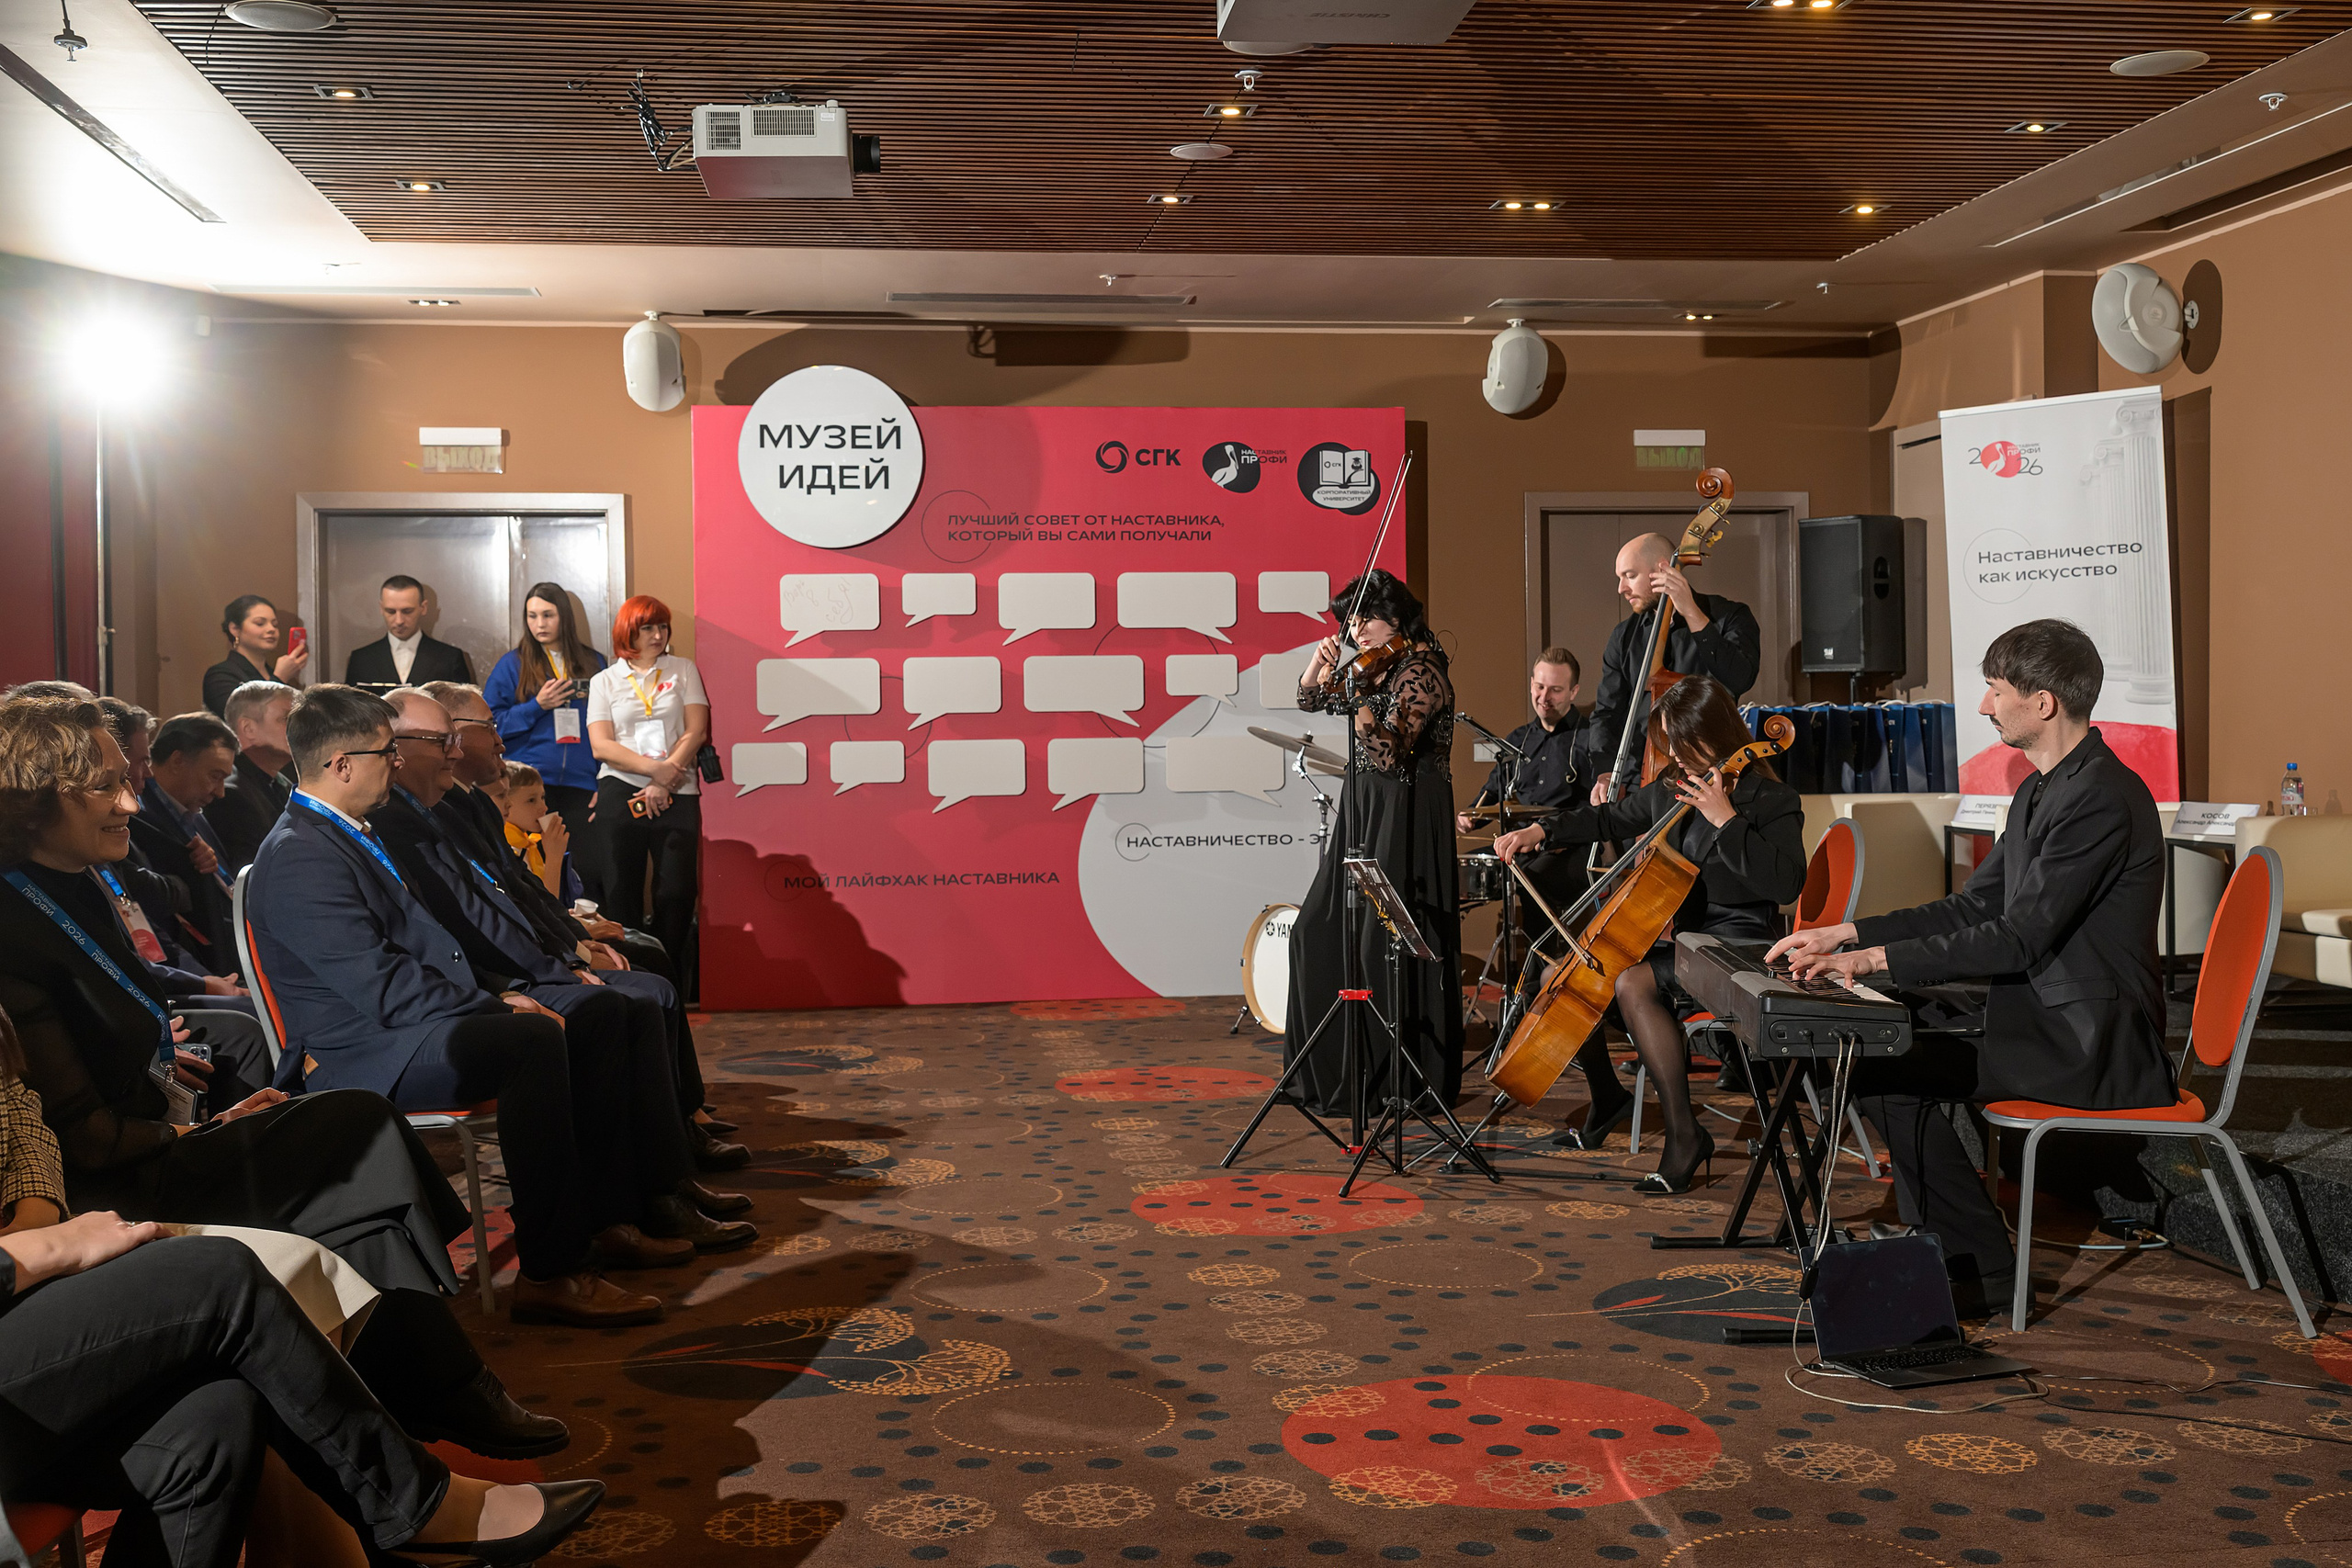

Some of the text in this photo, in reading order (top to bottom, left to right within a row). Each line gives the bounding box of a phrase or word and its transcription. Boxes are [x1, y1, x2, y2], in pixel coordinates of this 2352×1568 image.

[759, 418, 902, 449] МУЗЕЙ
[1136, 448, 1182, 466] СГК
[1241, 456, 1287, 464] ПРОФИ
[2007, 447, 2041, 457] ПРОФИ
[778, 457, 889, 495] ИДЕЙ
[948, 512, 1225, 527] ЛУЧШИЙ СОВЕТ ОТ НАСТАВНИКА,
[948, 527, 1212, 542] КОТОРЫЙ ВЫ САМИ ПОЛУЧАЛИ
[1978, 542, 2143, 564] Наставничество
[1979, 565, 2118, 583] как искусство
[1126, 833, 1294, 848] НАСТАВНИЧЕСТВО
[785, 871, 1060, 889] МОЙ ЛАЙФХАК НАСТАВНИКА
[21, 887, 54, 917] ПРОФИ
[62, 919, 85, 945] 2026
[91, 952, 120, 981] ПРОФИ
[127, 984, 151, 1008] 2026
